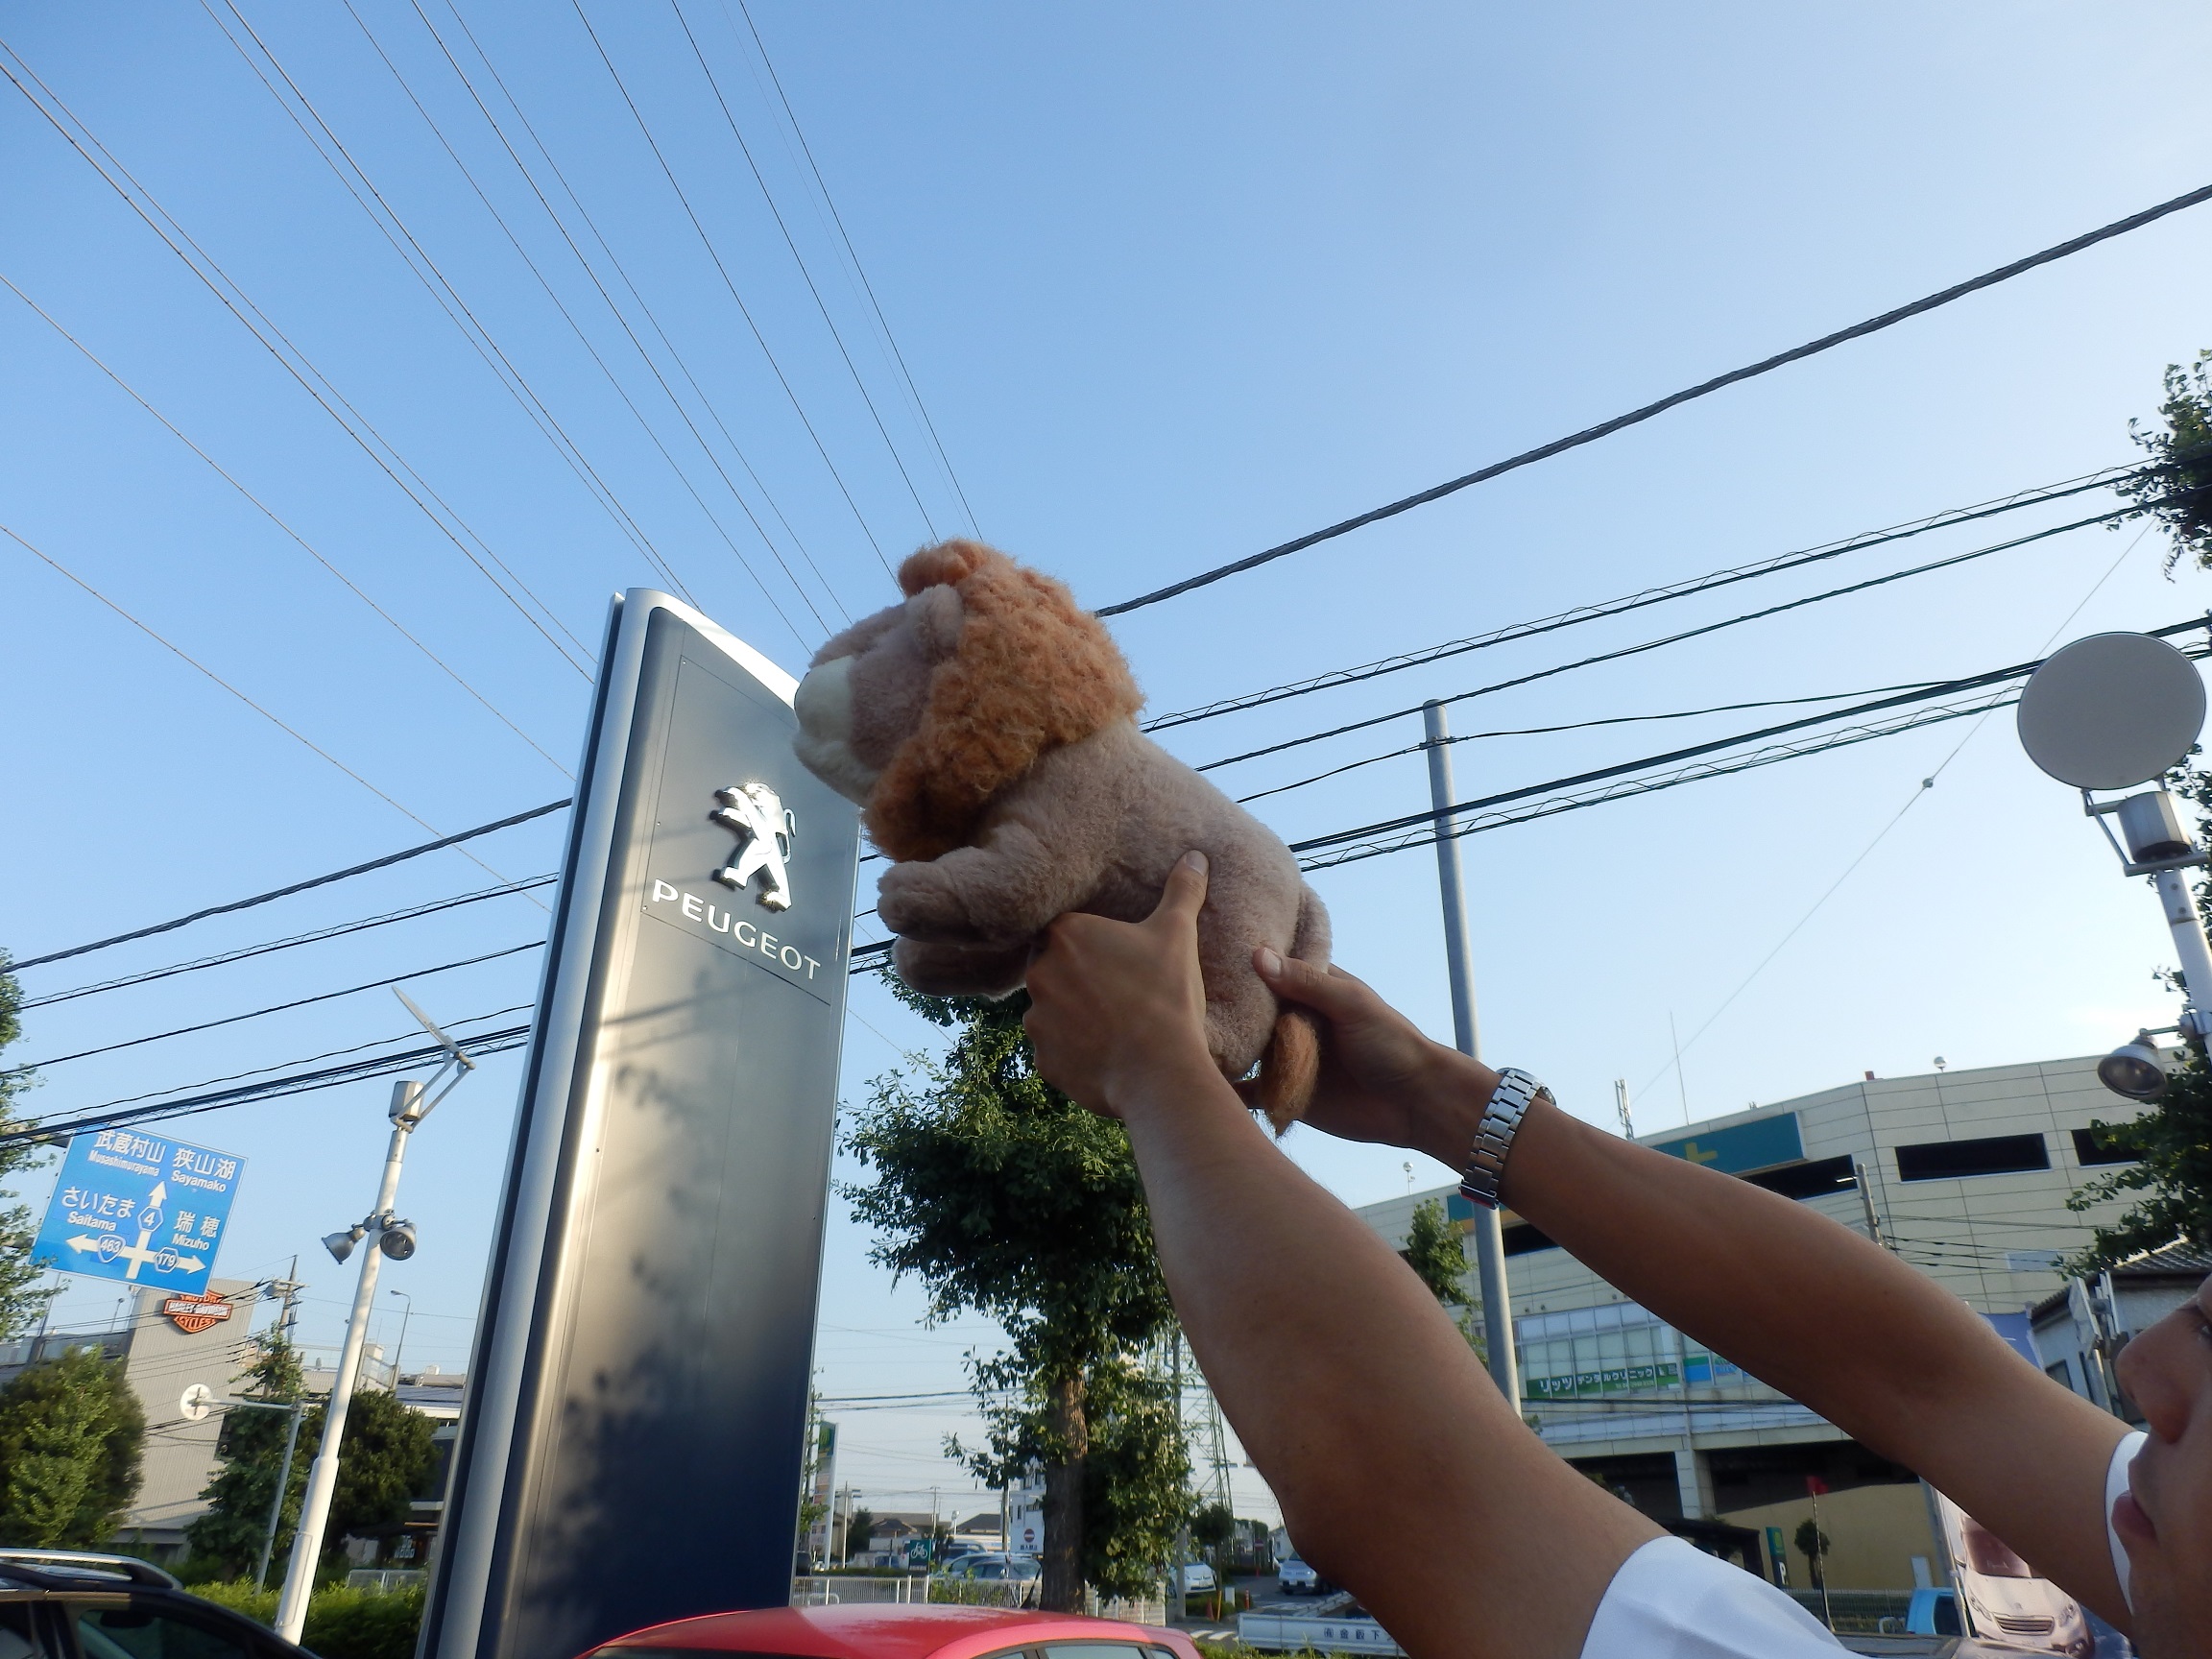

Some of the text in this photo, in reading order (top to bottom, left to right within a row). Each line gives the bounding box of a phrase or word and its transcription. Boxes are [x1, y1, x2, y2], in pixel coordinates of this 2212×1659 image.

[652, 878, 821, 980] PEUGEOT
[94, 1130, 166, 1164] 武蔵村山
[87, 1149, 160, 1177] Musashimurayama
[172, 1147, 236, 1180] 狭山湖
[171, 1169, 227, 1192] Sayamako
[61, 1186, 135, 1218] さいたま
[67, 1211, 117, 1232] Saitama
[144, 1212, 156, 1226] 4
[100, 1238, 121, 1253] 463
[171, 1234, 210, 1251] Mizuho
[158, 1253, 176, 1265] 179
[1778, 1561, 1787, 1585] P
